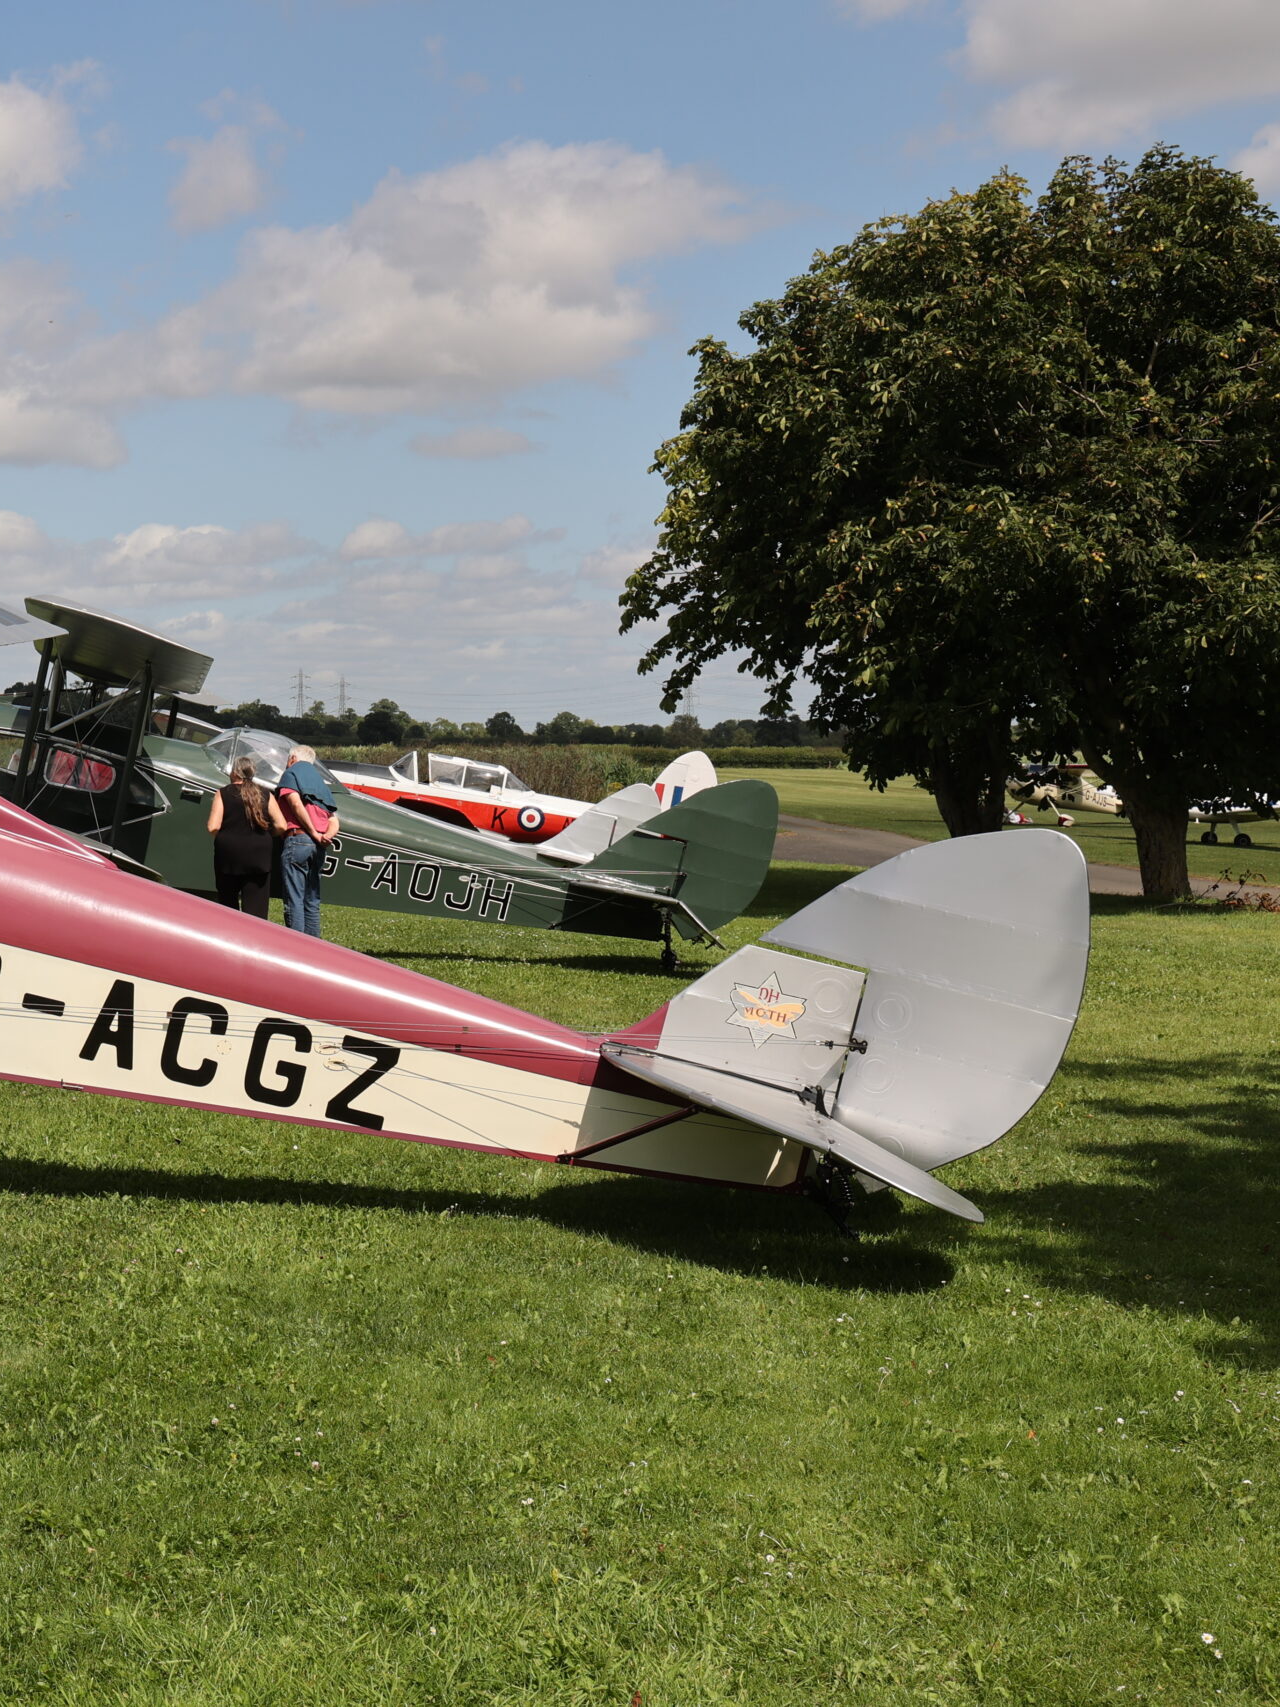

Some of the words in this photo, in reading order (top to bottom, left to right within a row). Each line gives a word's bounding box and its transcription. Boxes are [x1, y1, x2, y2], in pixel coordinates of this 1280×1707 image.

[491, 807, 508, 830] K
[321, 837, 515, 922] G-AOJH
[758, 987, 780, 1003] DH
